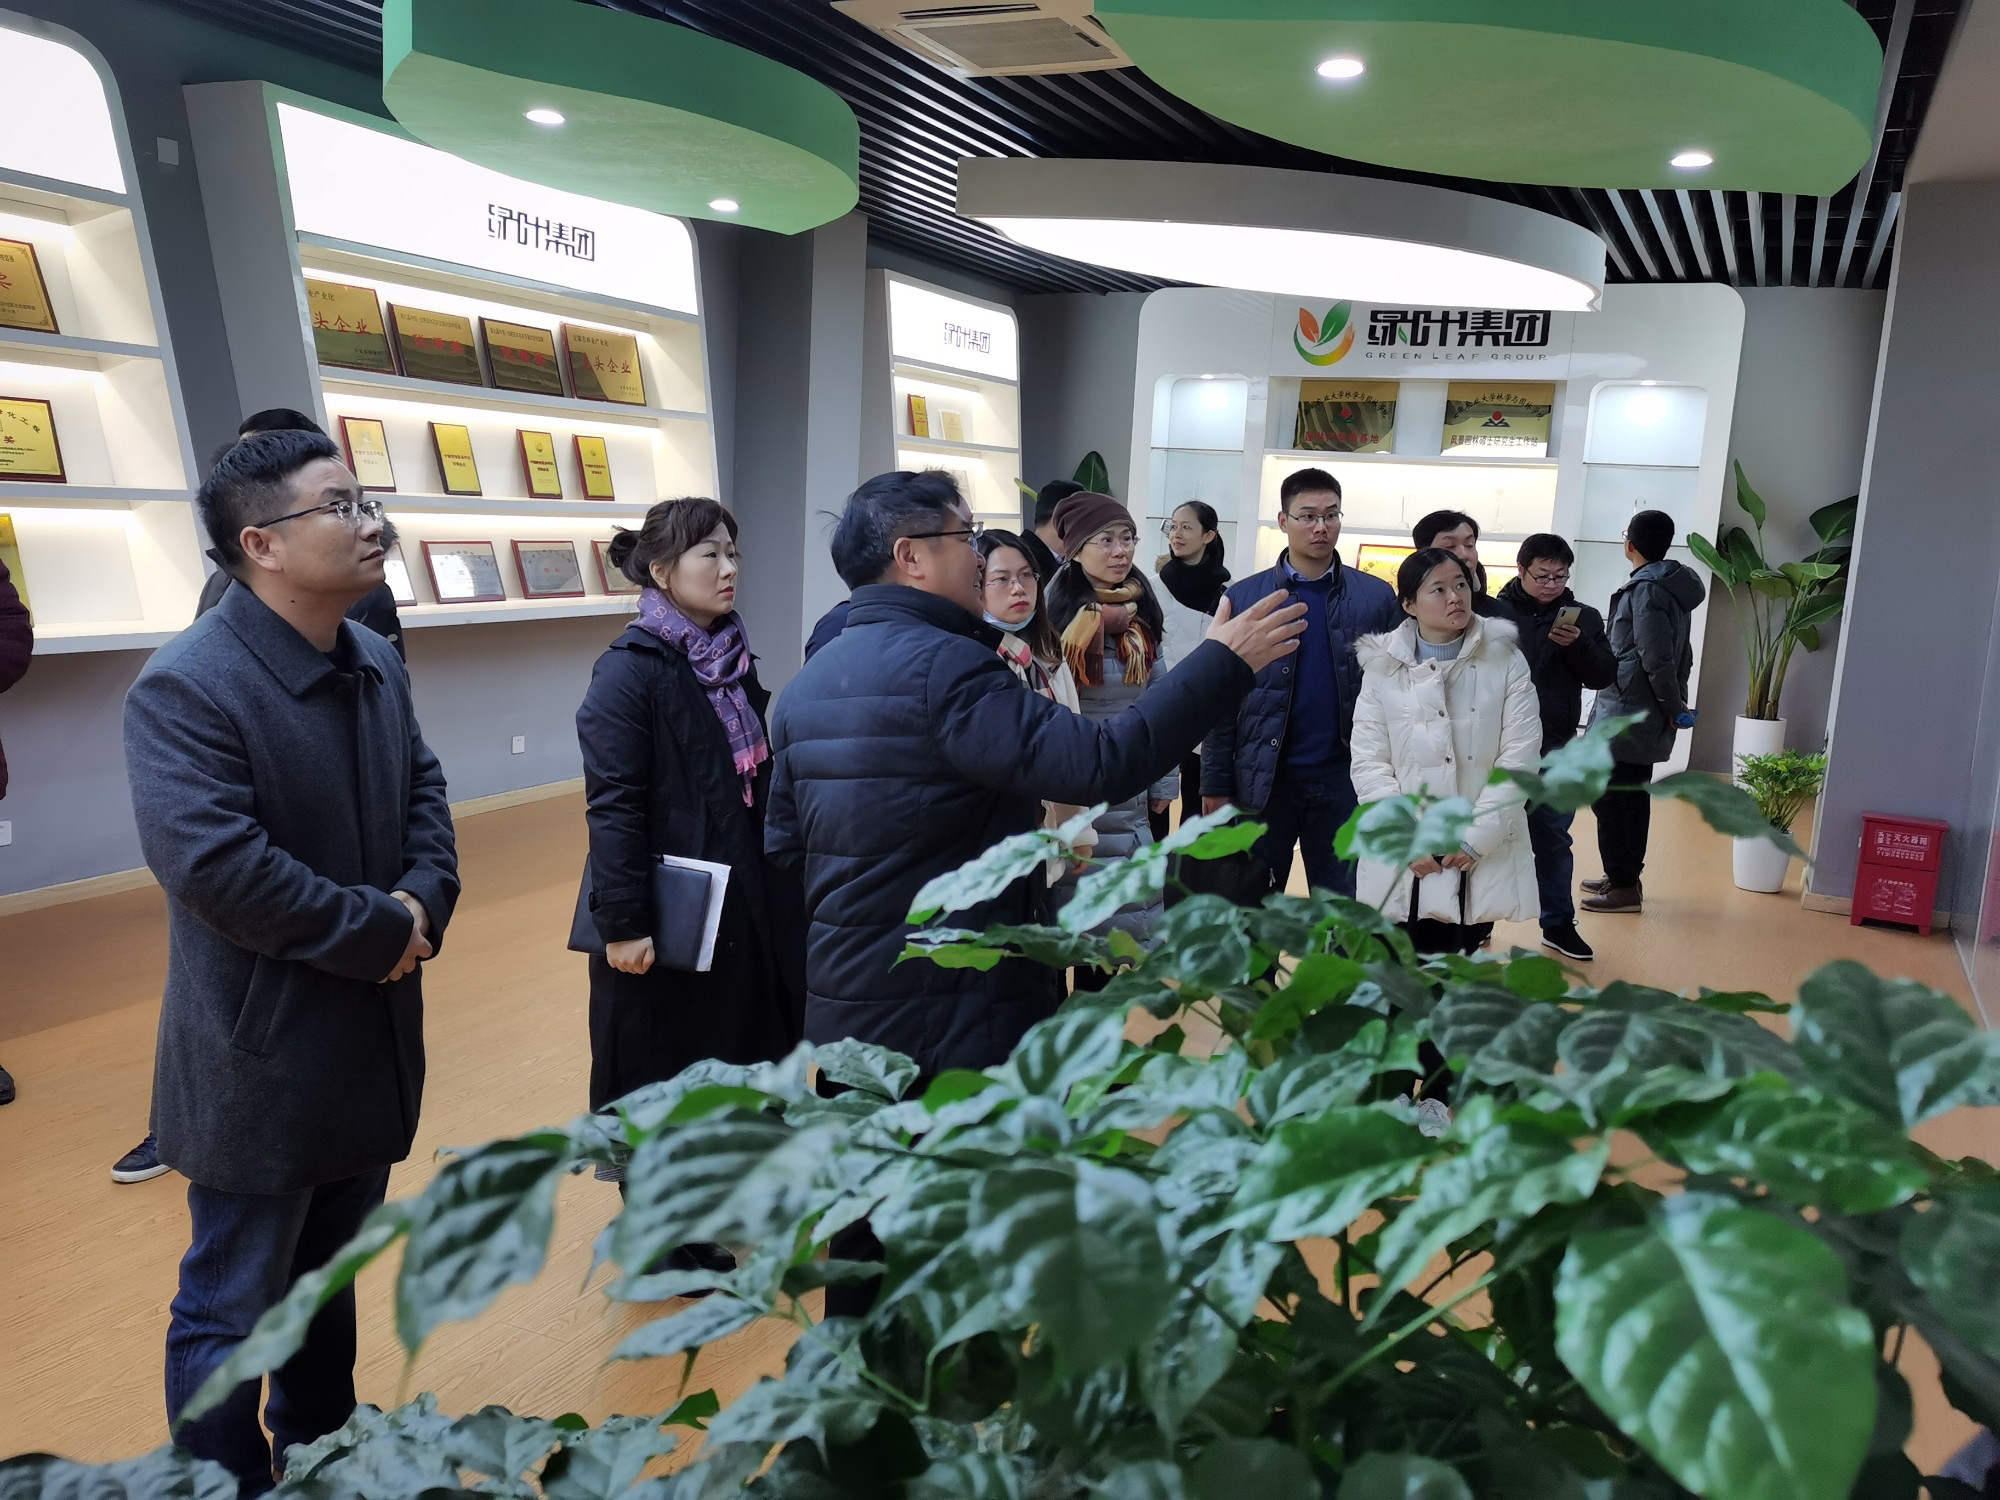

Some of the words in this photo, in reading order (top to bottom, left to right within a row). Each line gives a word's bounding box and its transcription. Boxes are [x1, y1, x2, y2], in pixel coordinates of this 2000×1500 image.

[488, 203, 595, 262] 绿叶集团
[944, 322, 991, 354] 绿叶集团
[1366, 309, 1552, 348] 绿叶集团
[1365, 351, 1422, 360] GREEN
[1432, 352, 1480, 361] LEAF
[1491, 353, 1548, 361] GROUP
[1450, 434, 1539, 447] 风景园林硕士研究生工作站
